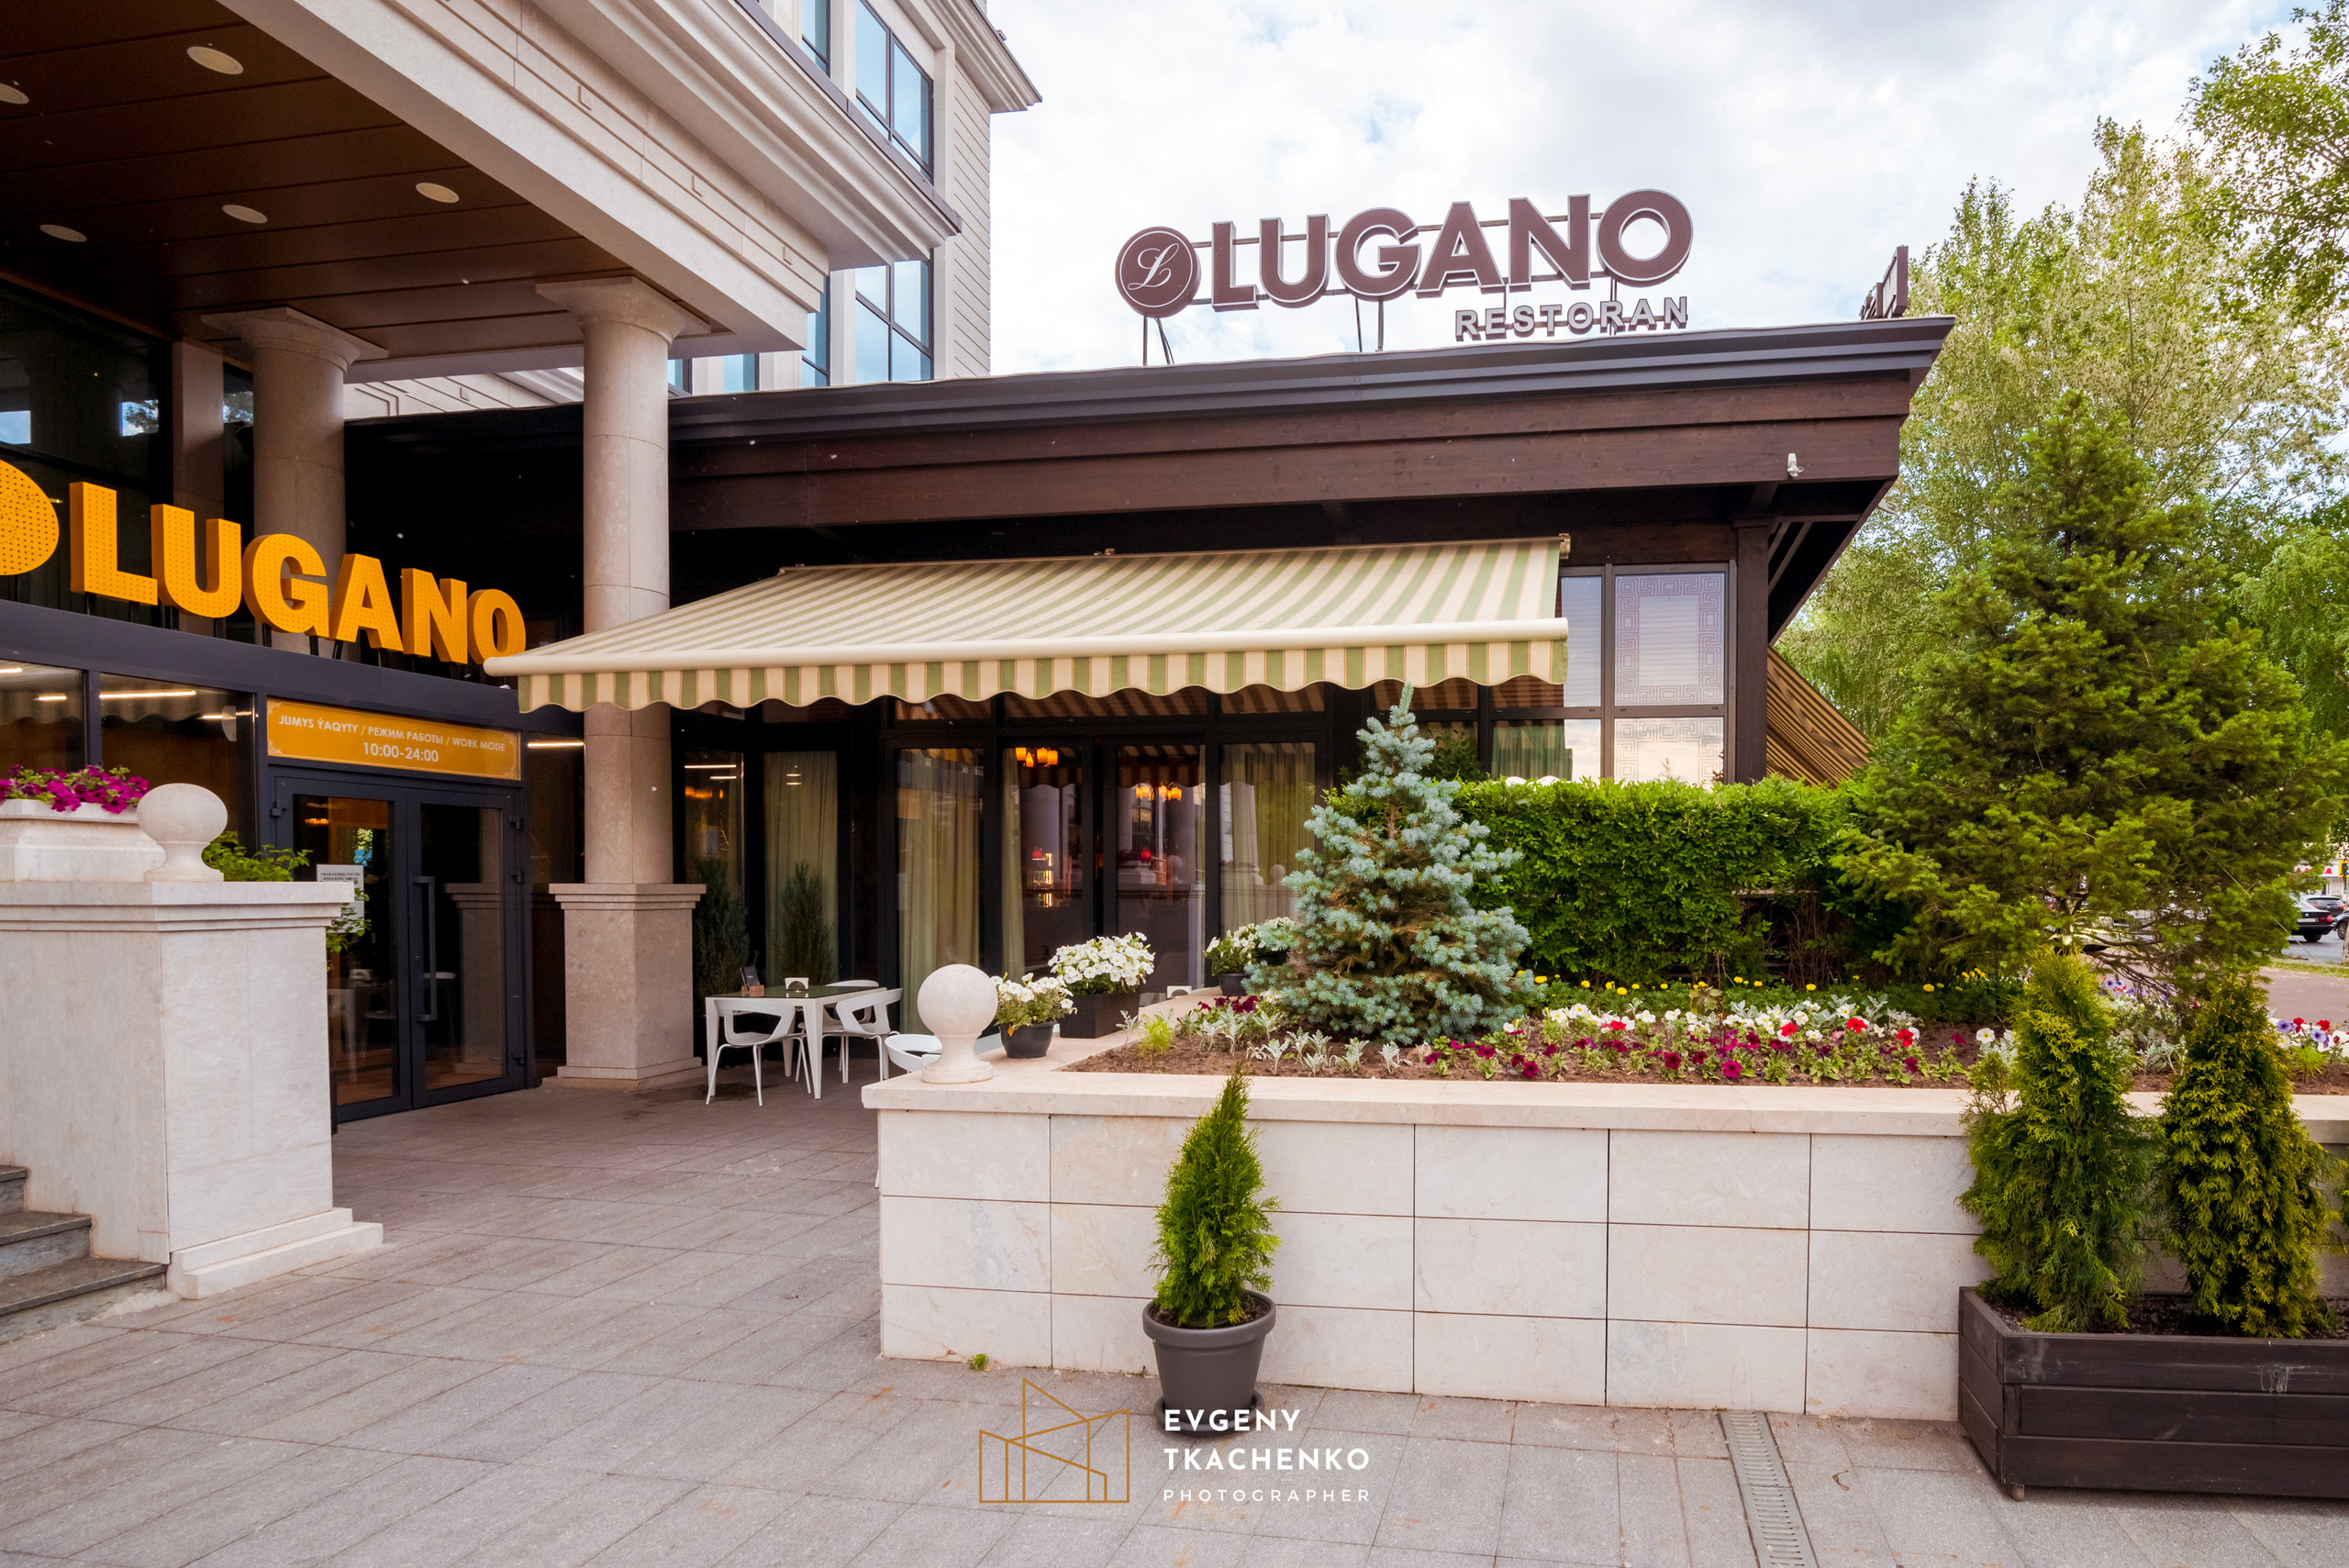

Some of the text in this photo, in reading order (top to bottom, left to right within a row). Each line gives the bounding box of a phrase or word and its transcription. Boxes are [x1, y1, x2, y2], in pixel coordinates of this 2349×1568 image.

[1211, 188, 1694, 312] LUGANO
[1454, 295, 1688, 340] RESTORAN
[70, 481, 527, 665] LUGANO
[278, 715, 315, 728] JUMYS
[368, 726, 405, 740] РЕЖИМ
[406, 731, 443, 744] РАБОТЫ
[452, 737, 478, 749] WORK
[479, 740, 506, 752] MODE
[363, 742, 440, 762] 10:00-24:00
